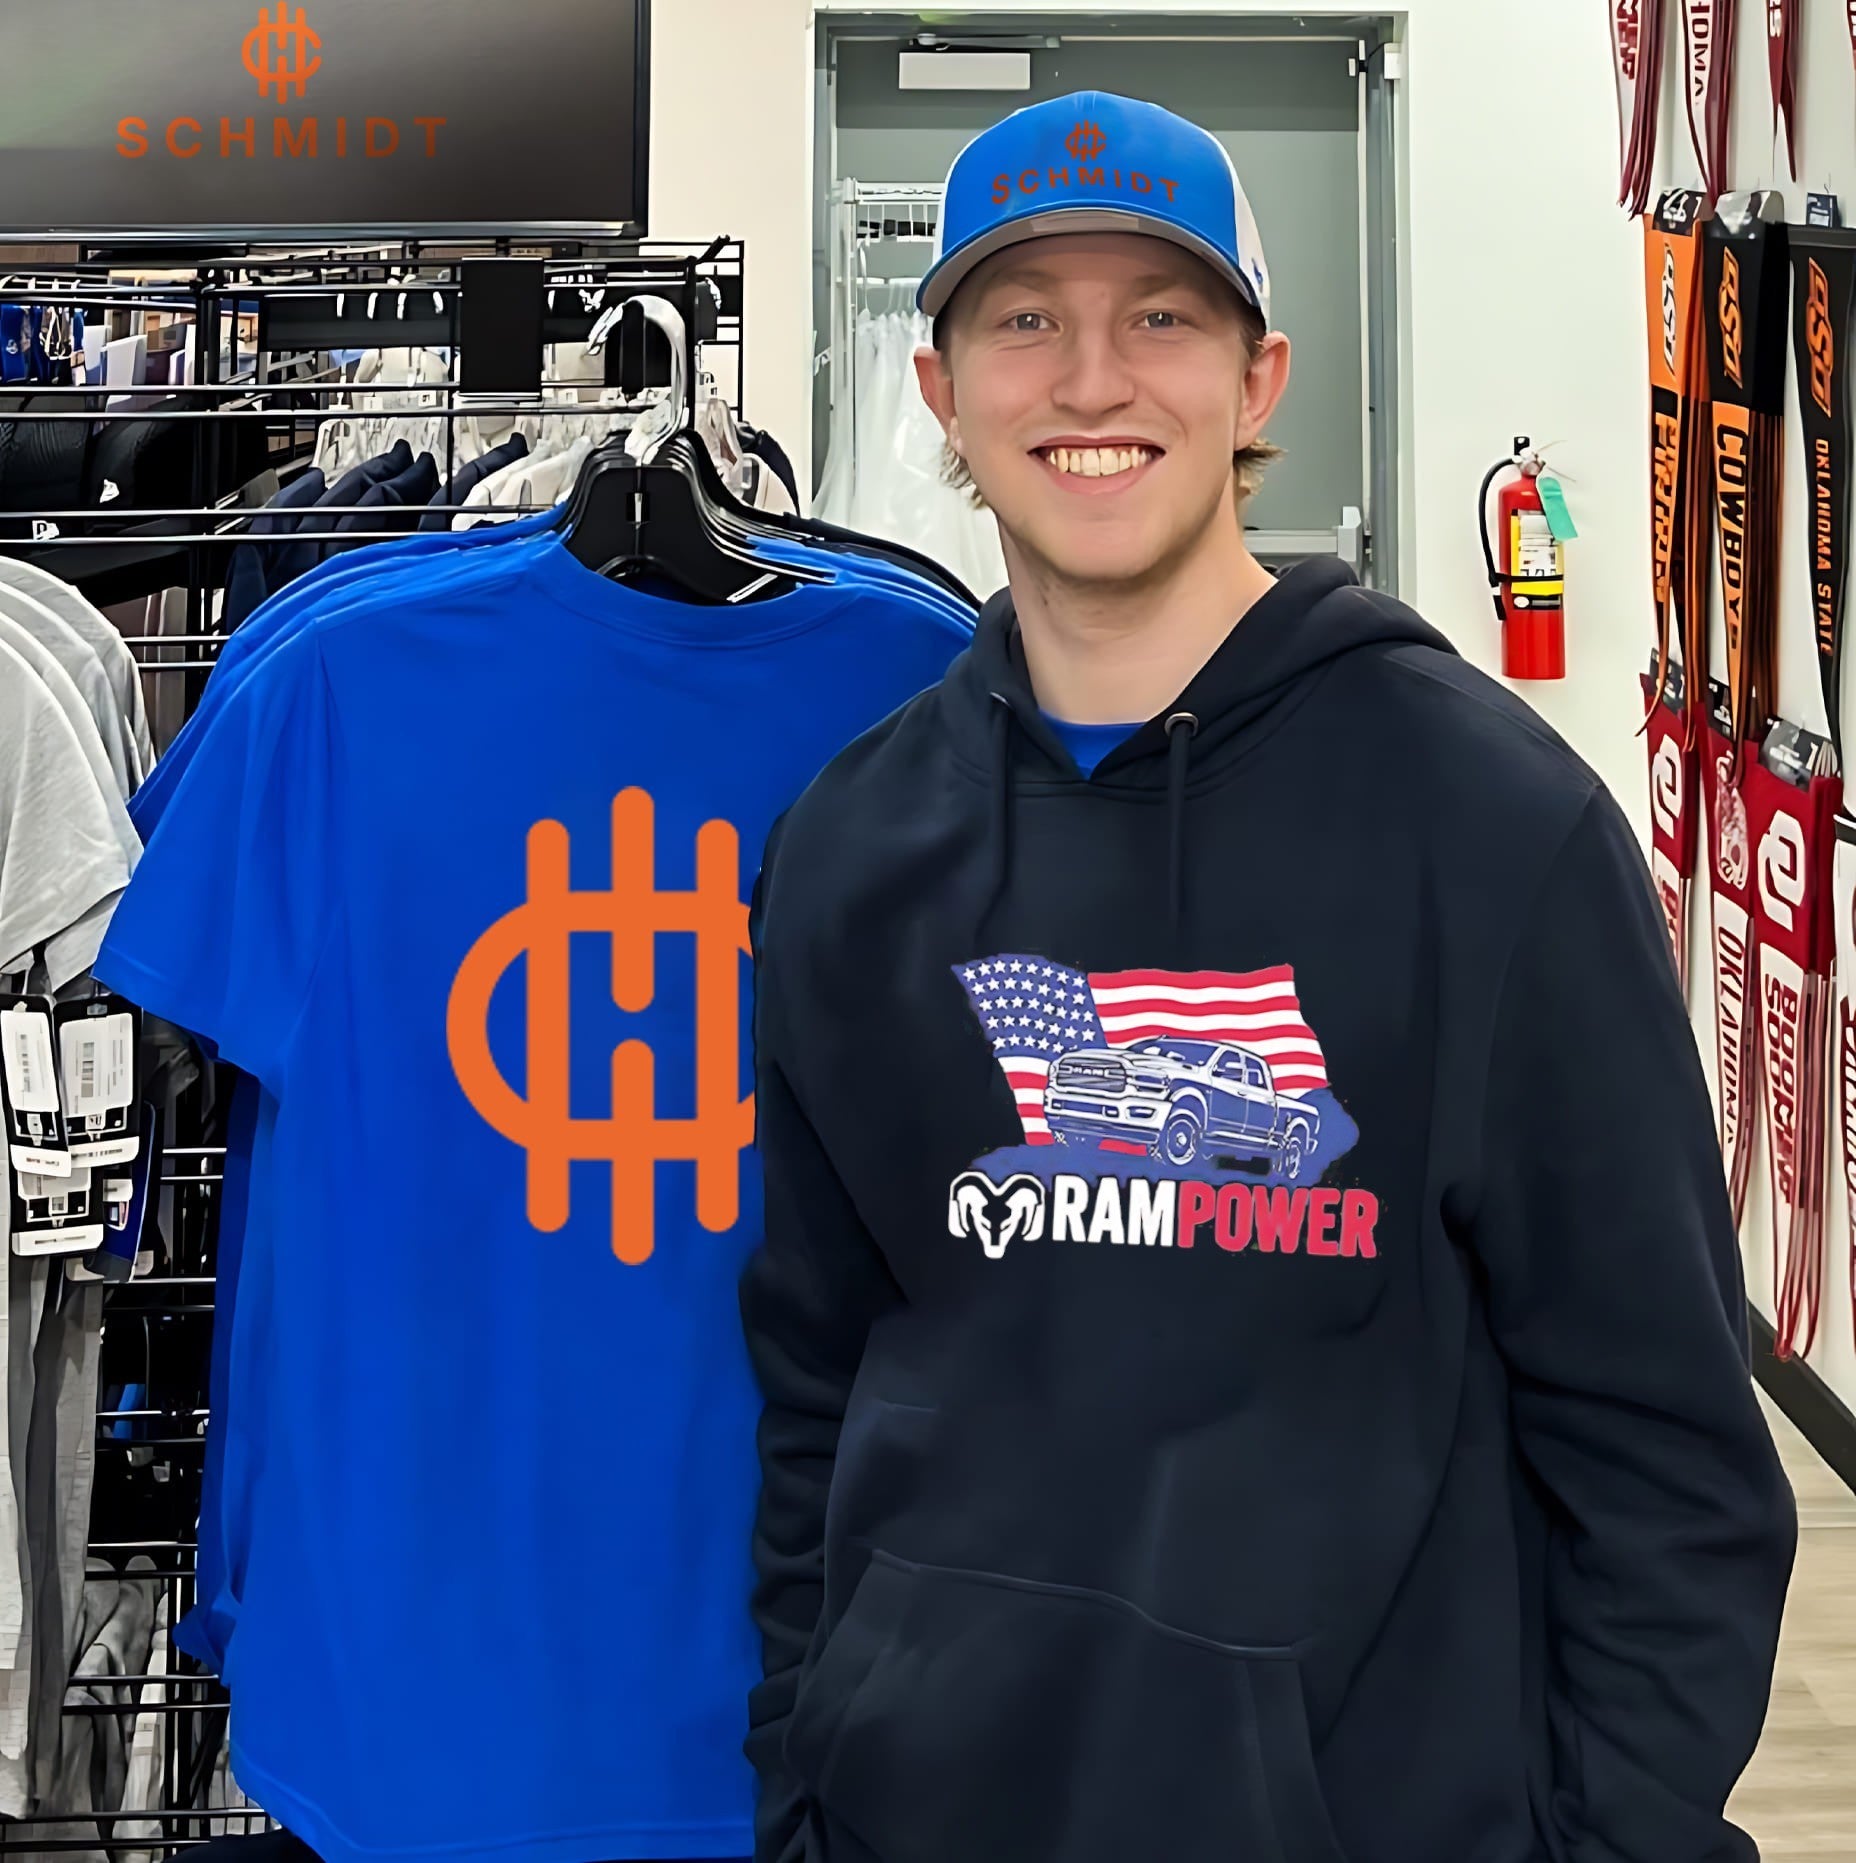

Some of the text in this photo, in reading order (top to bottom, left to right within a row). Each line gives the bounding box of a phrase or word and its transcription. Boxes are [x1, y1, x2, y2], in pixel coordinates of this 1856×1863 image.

[116, 117, 447, 158] SCHMIDT
[991, 166, 1179, 205] SCHMIDT
[1815, 438, 1832, 571] OKLAHOMA
